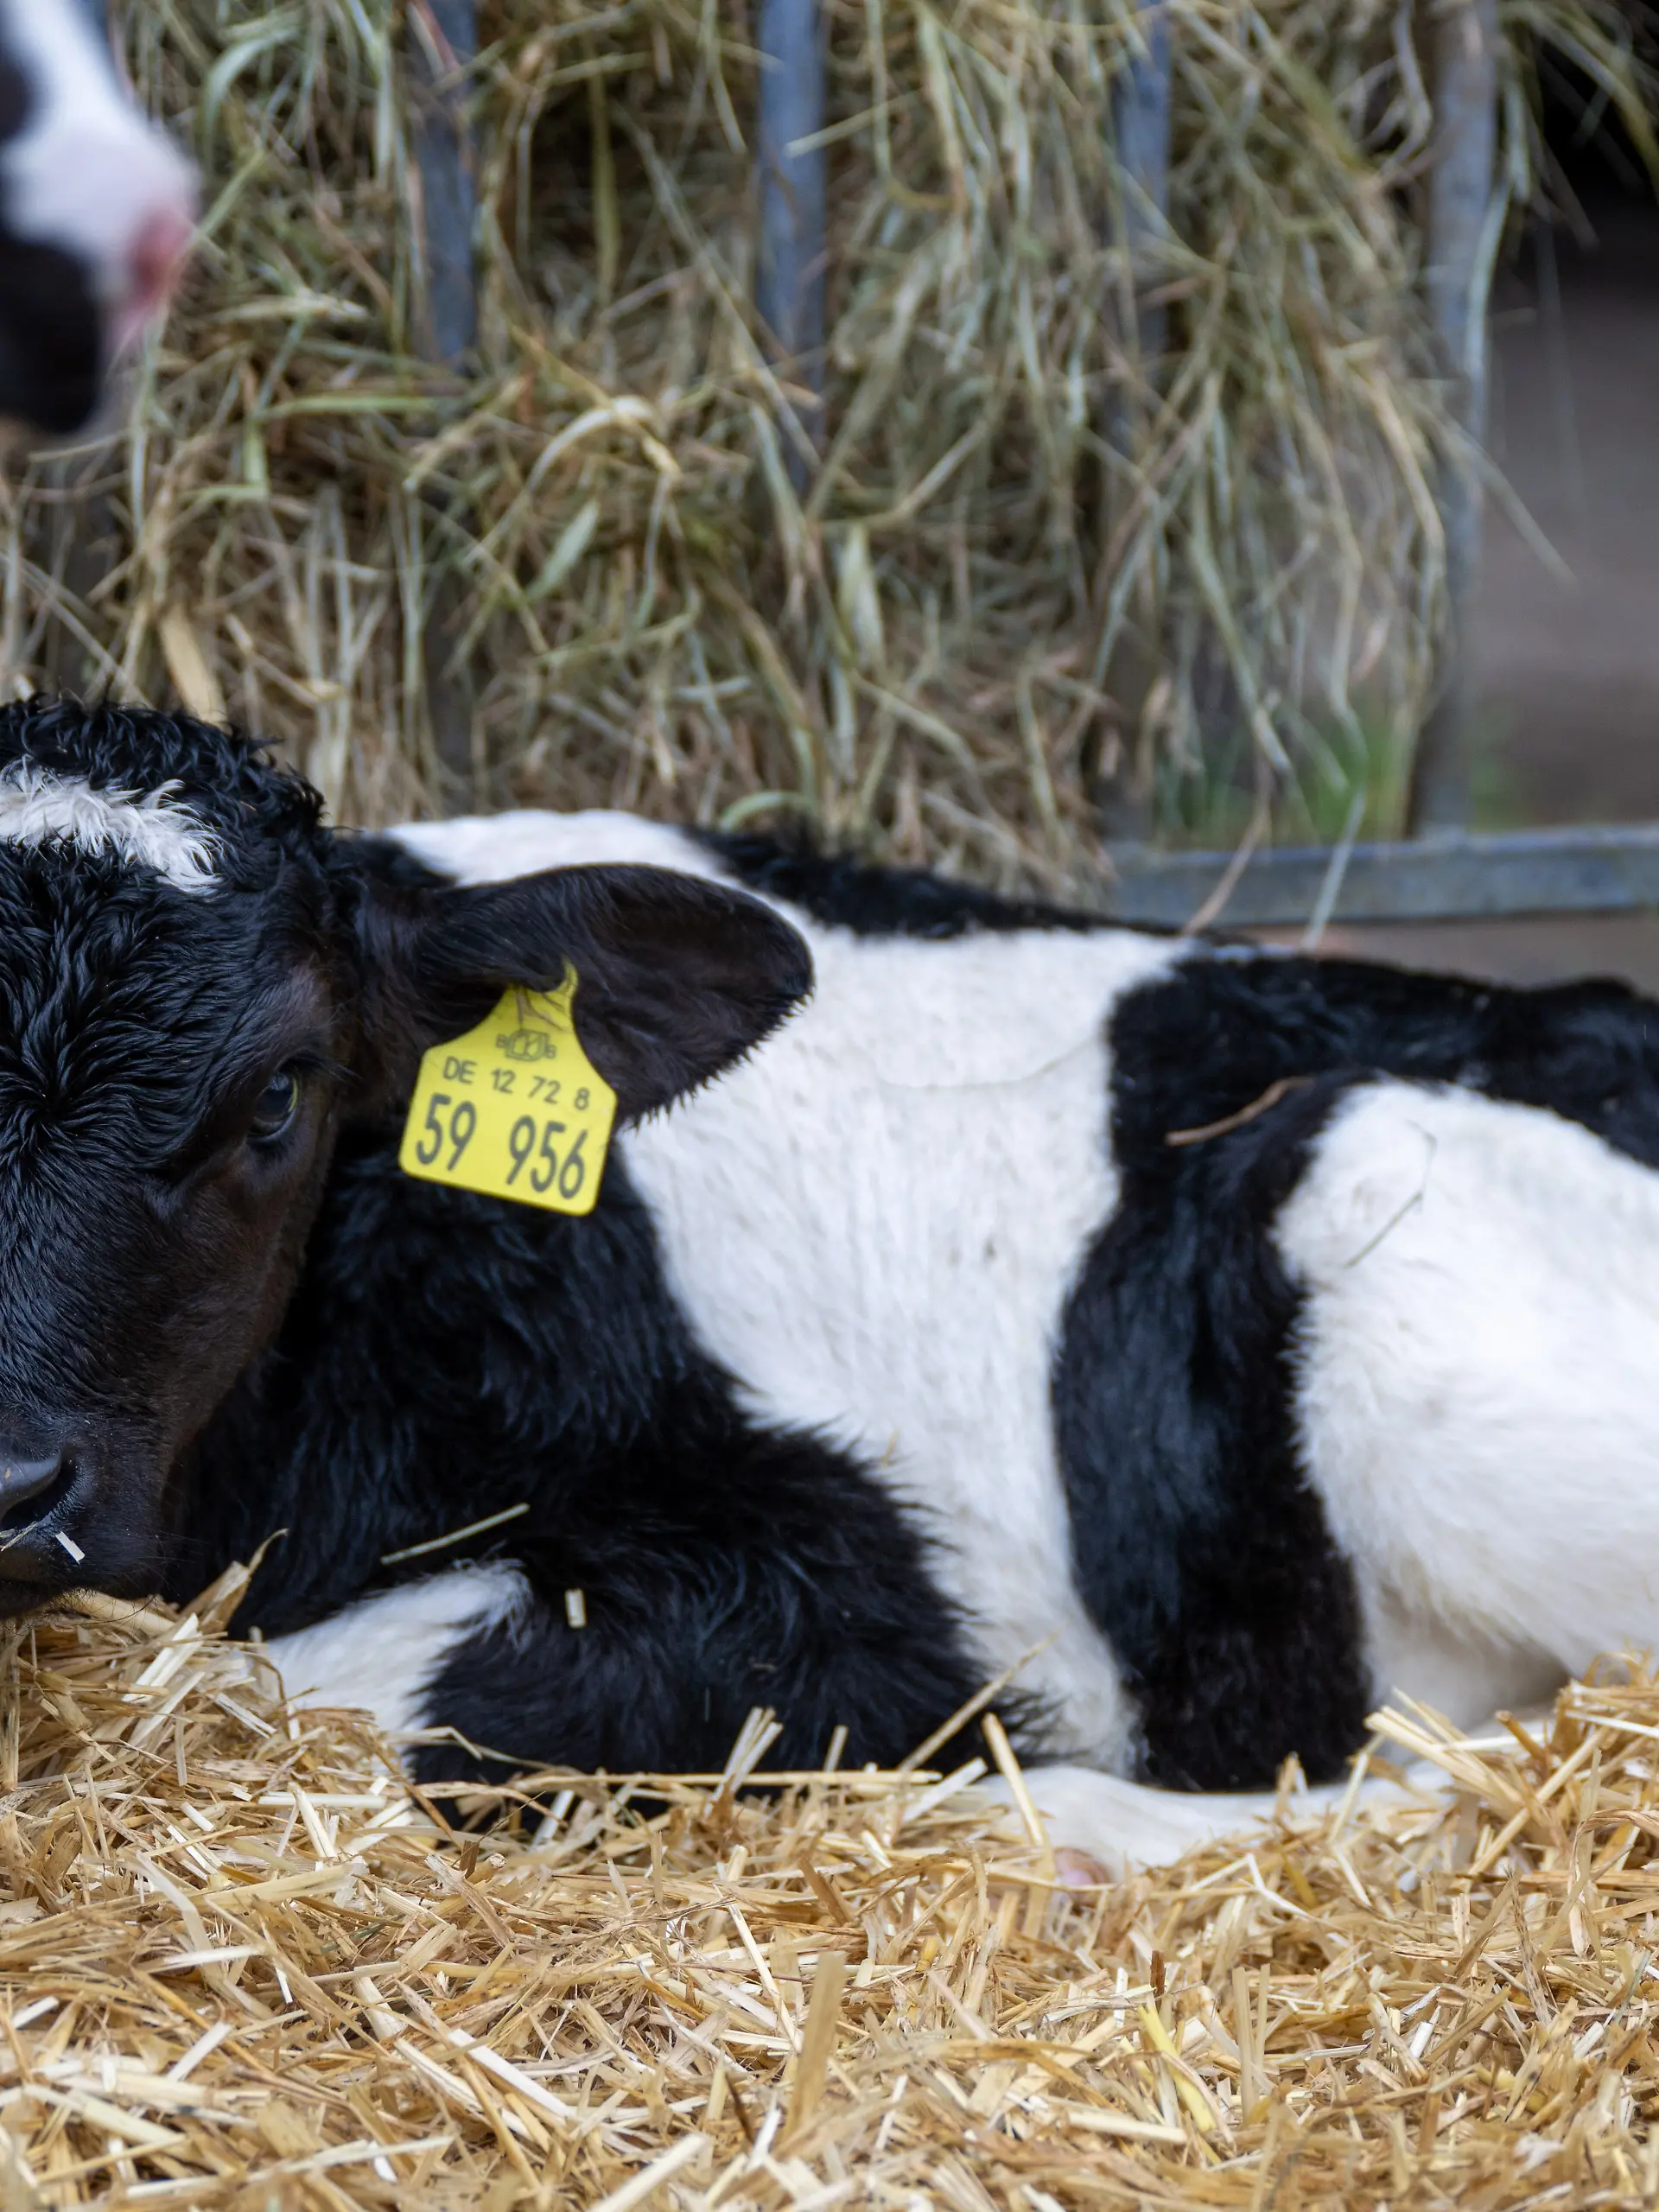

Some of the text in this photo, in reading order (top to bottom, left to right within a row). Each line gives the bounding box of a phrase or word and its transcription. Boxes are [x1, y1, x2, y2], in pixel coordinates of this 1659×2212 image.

[442, 1056, 590, 1111] DE 12 72 8
[416, 1092, 588, 1199] 59 956
